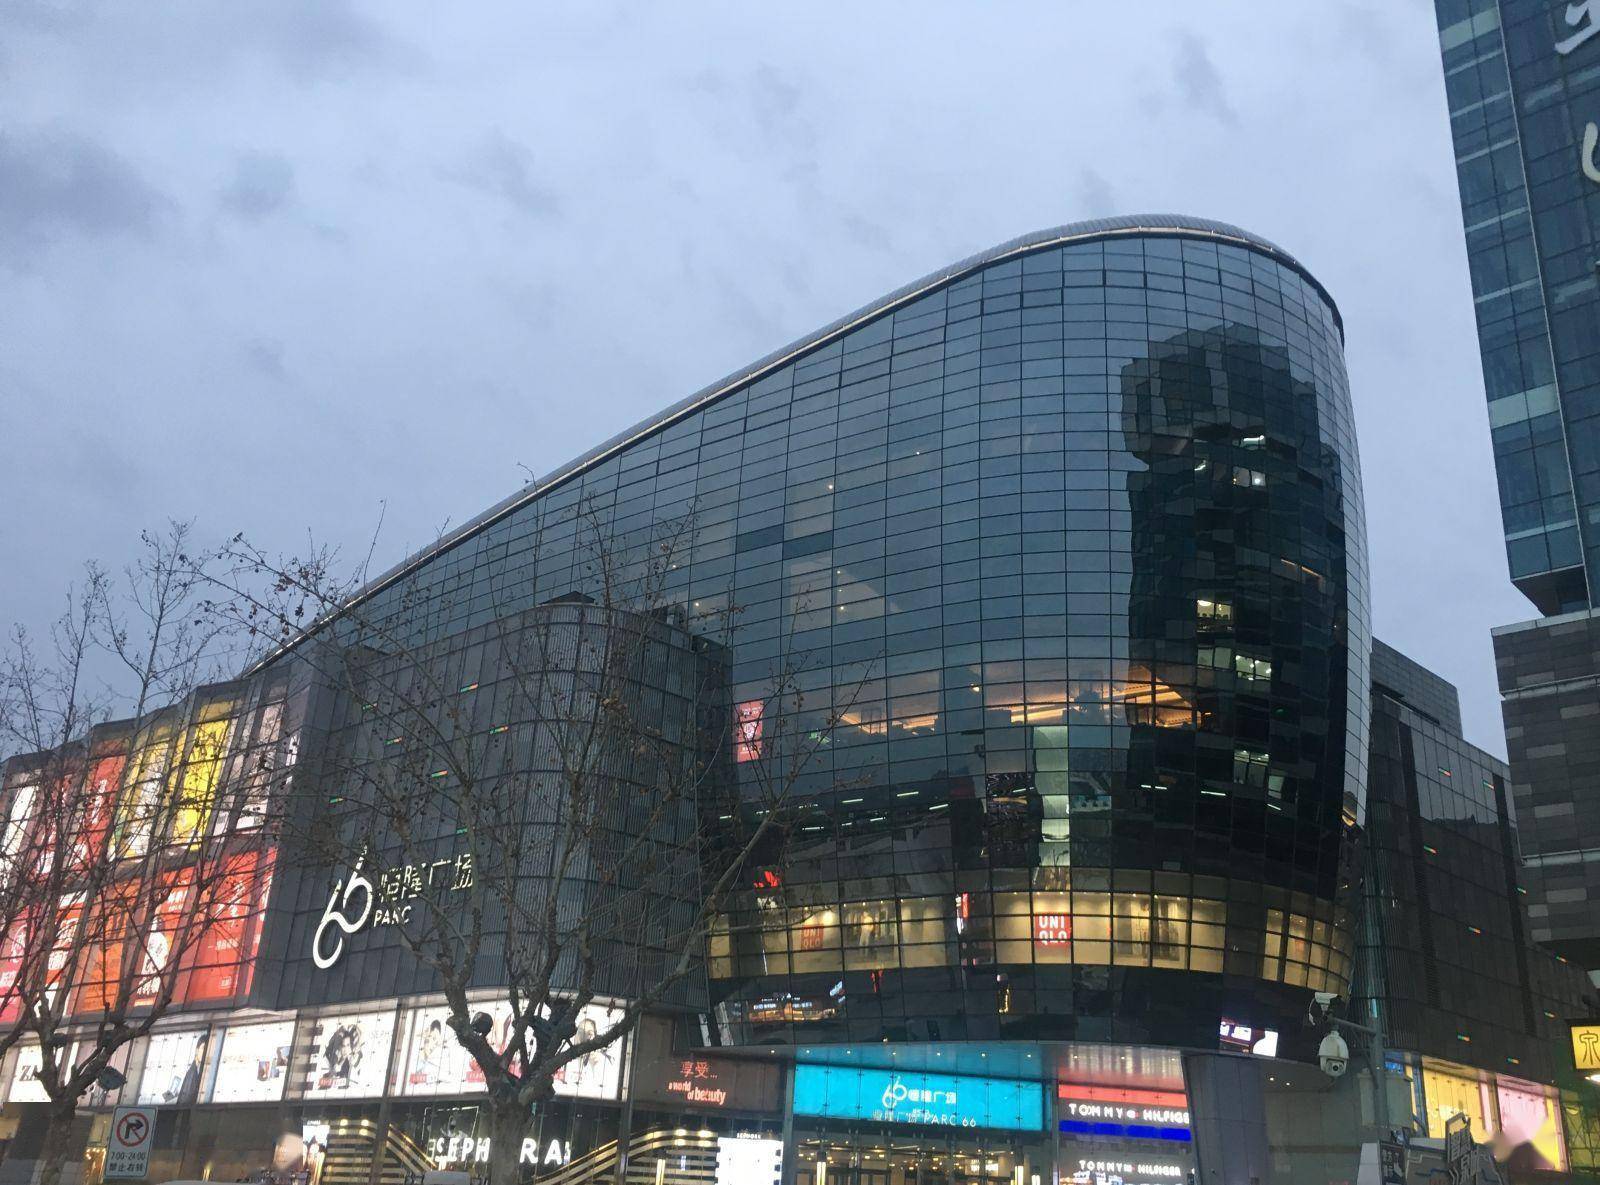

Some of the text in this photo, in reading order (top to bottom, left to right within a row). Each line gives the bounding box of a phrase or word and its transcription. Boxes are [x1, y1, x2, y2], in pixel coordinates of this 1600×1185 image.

[1038, 915, 1066, 929] UNI
[1038, 930, 1068, 946] QLO
[673, 1081, 692, 1092] world
[687, 1086, 727, 1106] of beauty
[1068, 1102, 1123, 1120] TOMMY
[923, 1113, 977, 1128] PARC 66
[434, 1136, 563, 1166] SEPHRA
[1078, 1159, 1123, 1173] TOMMY
